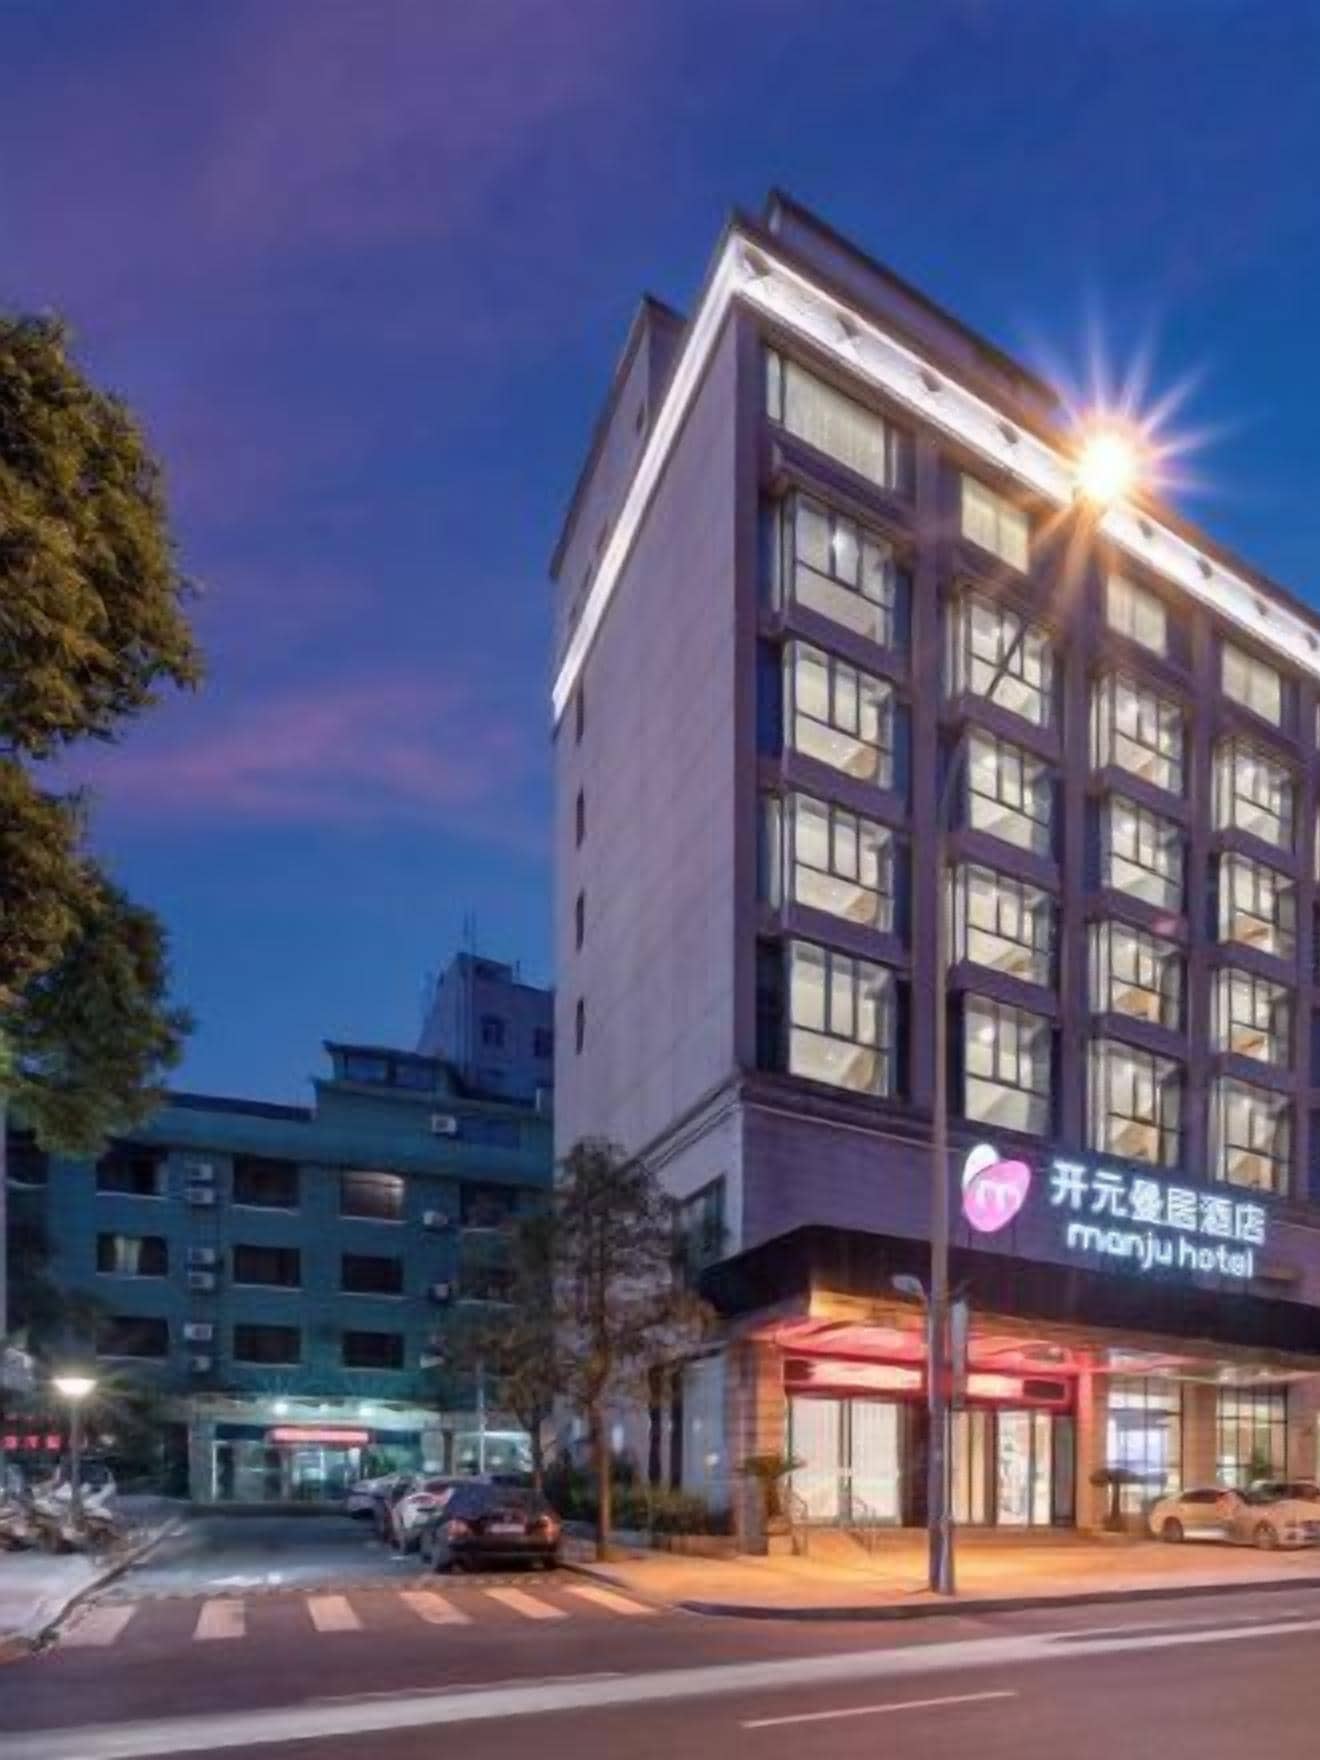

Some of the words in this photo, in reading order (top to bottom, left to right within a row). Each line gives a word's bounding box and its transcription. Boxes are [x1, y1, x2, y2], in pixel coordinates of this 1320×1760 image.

[1050, 1160, 1264, 1245] 开元曼居酒店
[1066, 1223, 1173, 1270] manju
[1179, 1235, 1254, 1278] hotel
